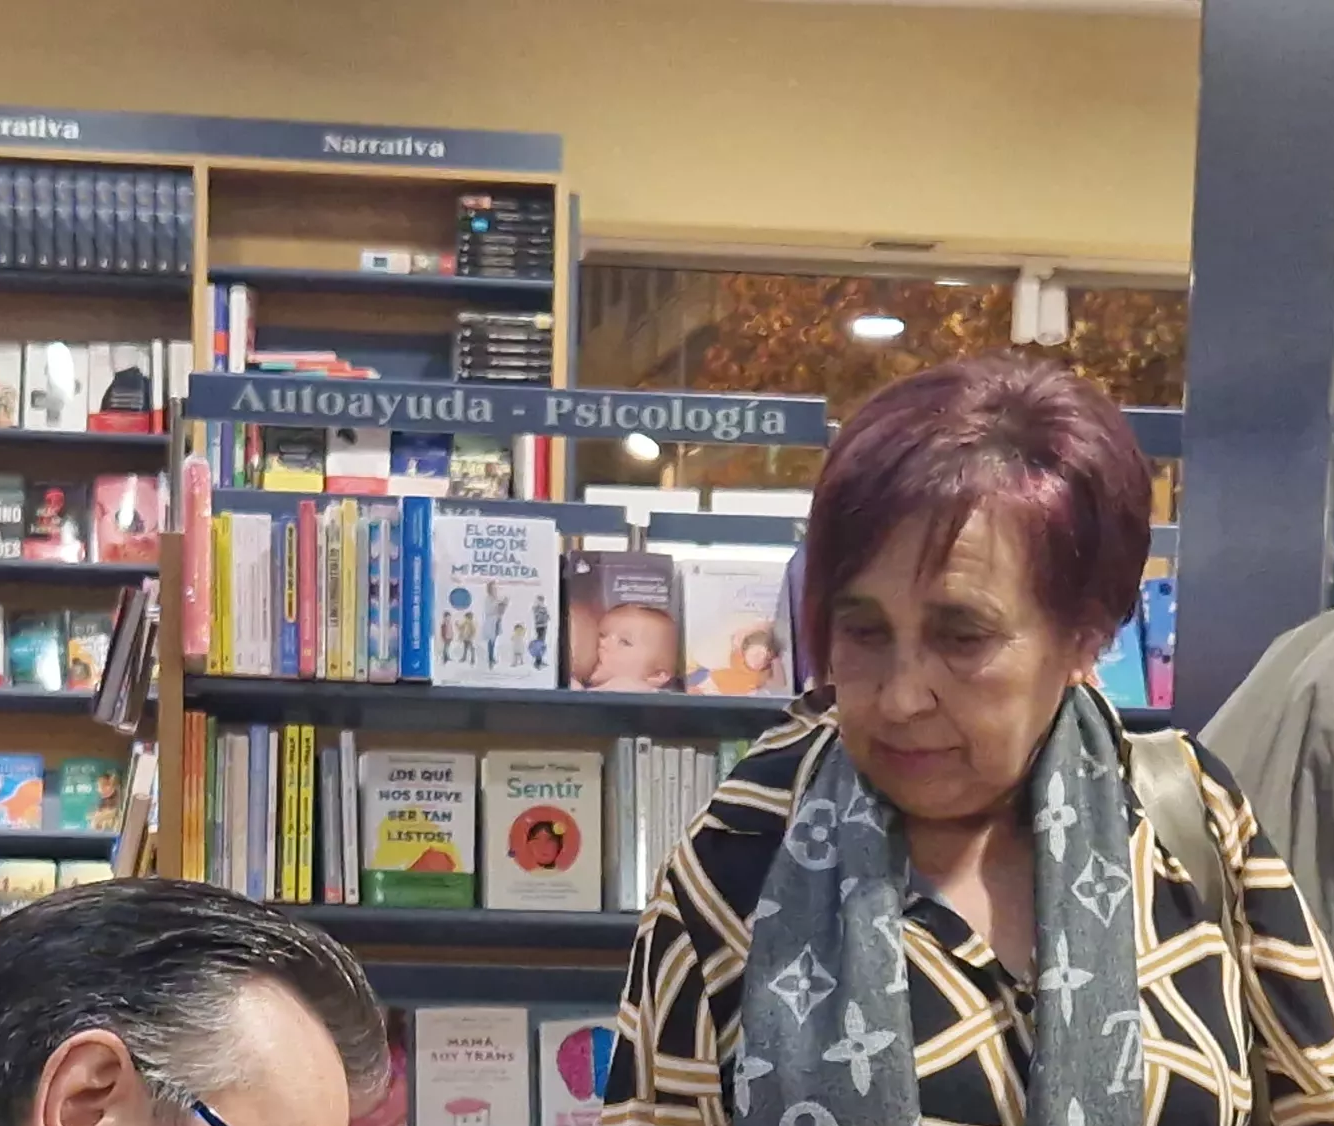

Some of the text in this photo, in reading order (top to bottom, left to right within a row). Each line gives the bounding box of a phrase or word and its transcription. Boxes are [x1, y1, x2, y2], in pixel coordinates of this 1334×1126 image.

[323, 133, 446, 159] Narrativa
[231, 380, 494, 425] Autoayuda
[544, 394, 787, 441] Psicología
[466, 524, 526, 537] EL GRAN
[463, 538, 528, 551] LIBRO DE
[451, 564, 539, 578] MI PEDIATRA
[420, 767, 454, 782] QUÉ
[507, 776, 583, 799] Sentir
[379, 790, 463, 804] NOS SIRVE
[387, 810, 452, 823] SER TAN
[387, 830, 453, 844] LISTOS?
